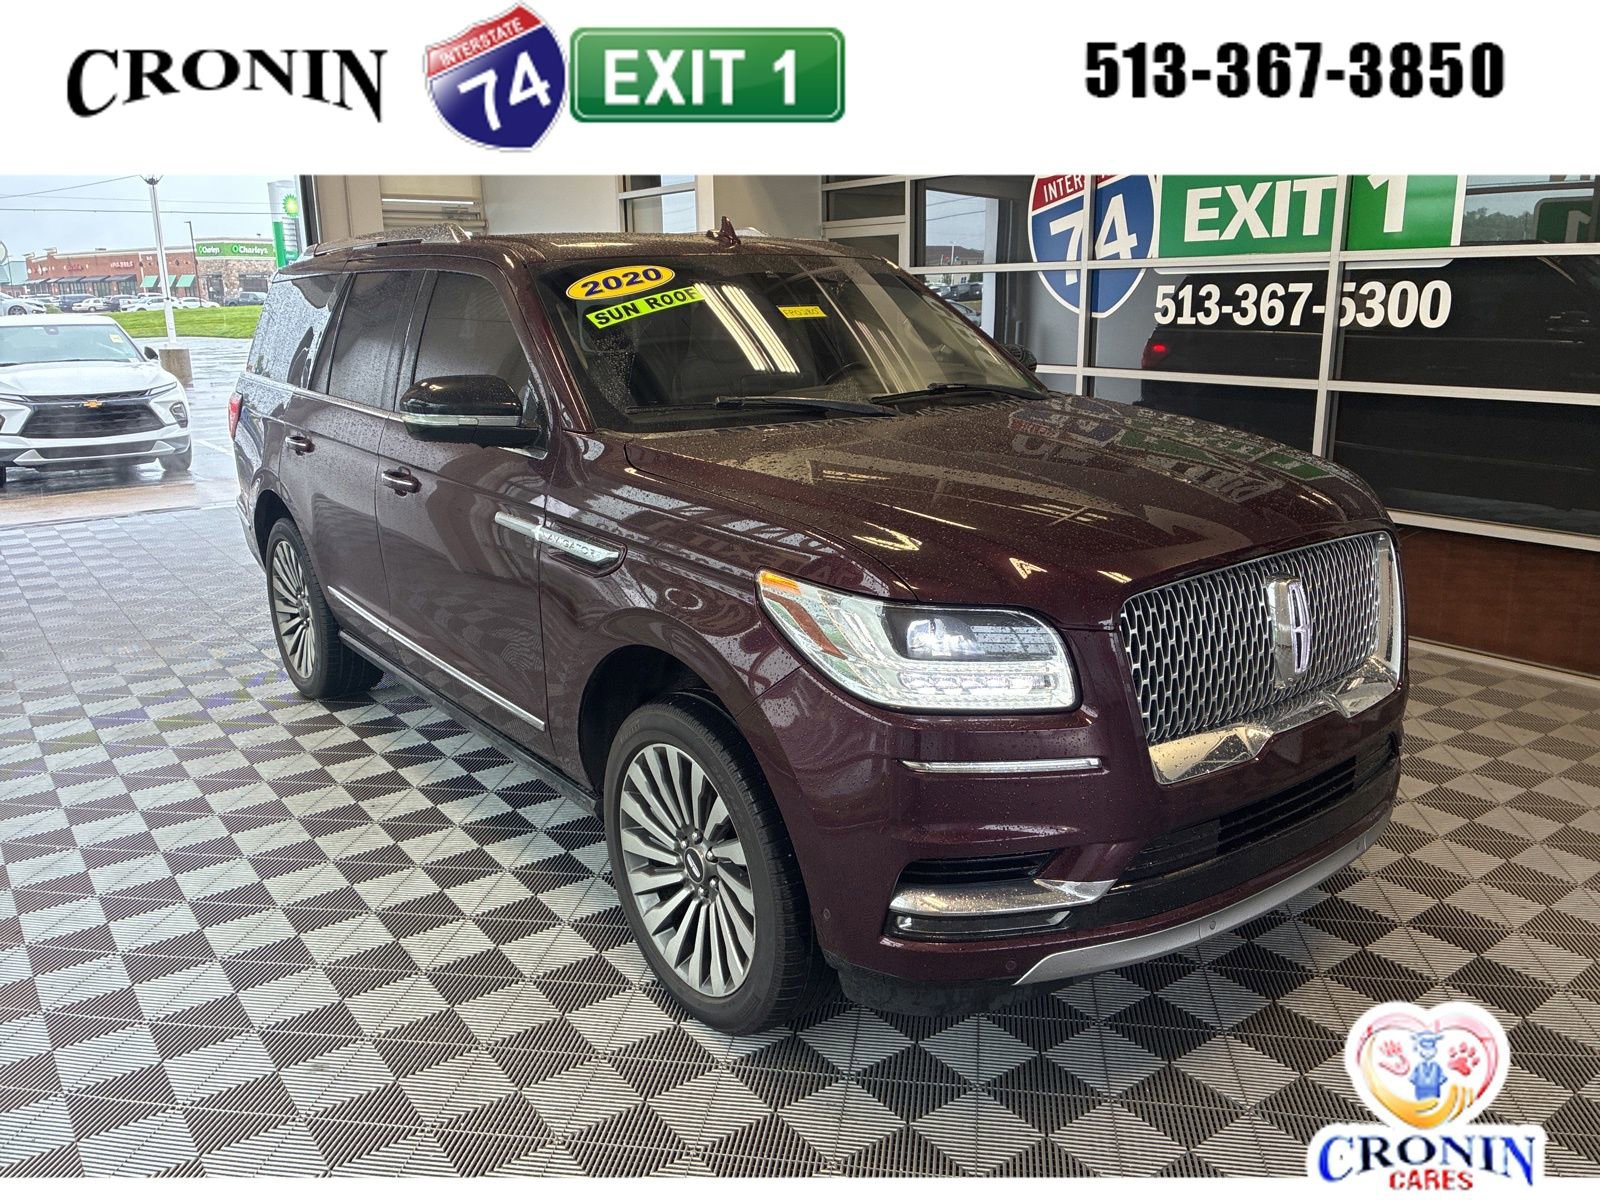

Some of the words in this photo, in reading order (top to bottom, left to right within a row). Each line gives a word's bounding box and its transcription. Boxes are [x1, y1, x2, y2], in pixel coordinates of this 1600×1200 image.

[1184, 175, 1337, 242] EXIT
[1367, 175, 1408, 233] 1
[1049, 194, 1138, 286] 74
[581, 268, 662, 297] 2020
[595, 303, 640, 325] SUN
[644, 288, 698, 309] ROOF
[1153, 280, 1452, 329] 513-367-5300
